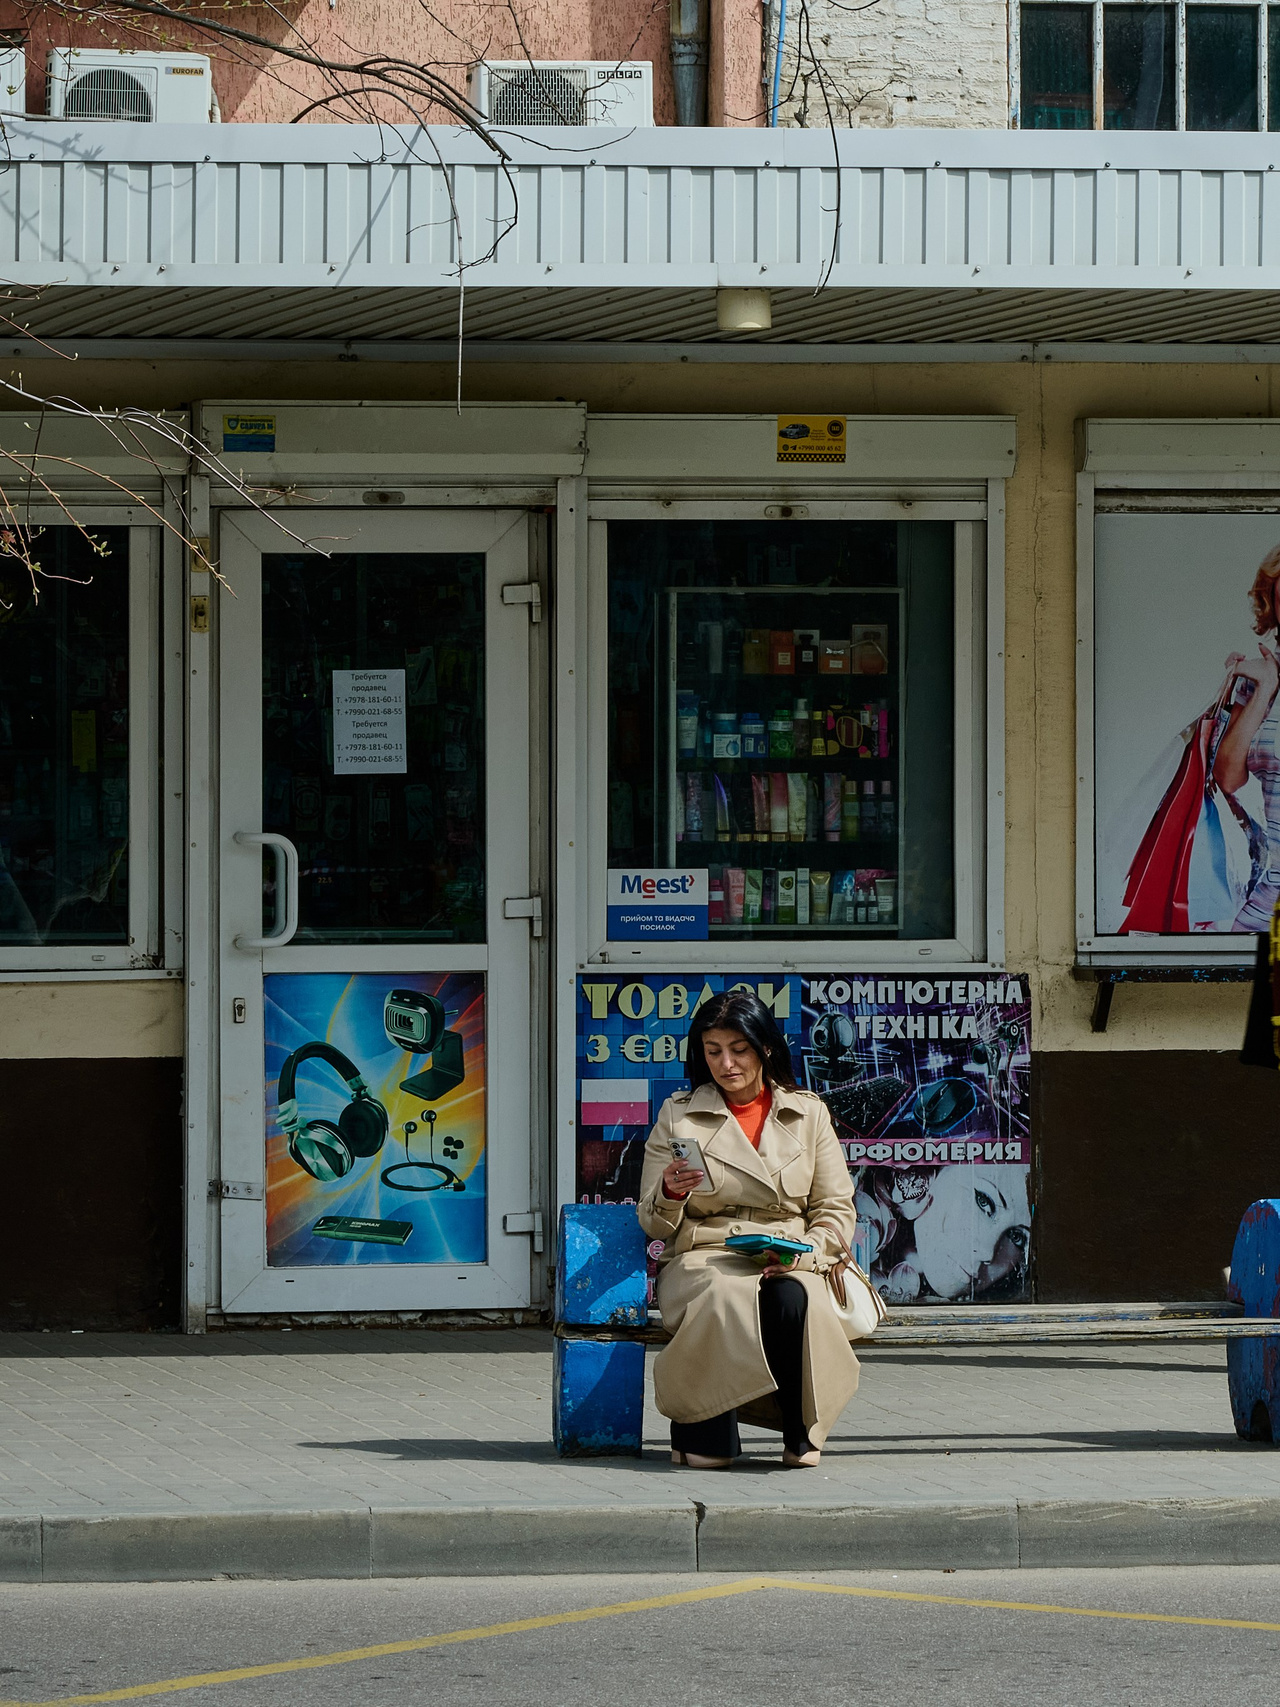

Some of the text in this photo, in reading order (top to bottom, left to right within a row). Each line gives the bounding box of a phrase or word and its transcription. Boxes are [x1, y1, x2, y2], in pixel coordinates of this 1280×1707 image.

[172, 68, 204, 76] EUROFAN
[598, 71, 641, 79] DELFA
[351, 673, 387, 681] Требуется
[352, 720, 388, 728] Требуется
[621, 874, 690, 896] Meest
[620, 914, 653, 923] прийом
[809, 980, 1024, 1004] КОМП'ЮТЕРНА
[854, 1015, 978, 1039] ТЕХНІКА
[840, 1141, 1022, 1162] РФЮМЕРИЯ
